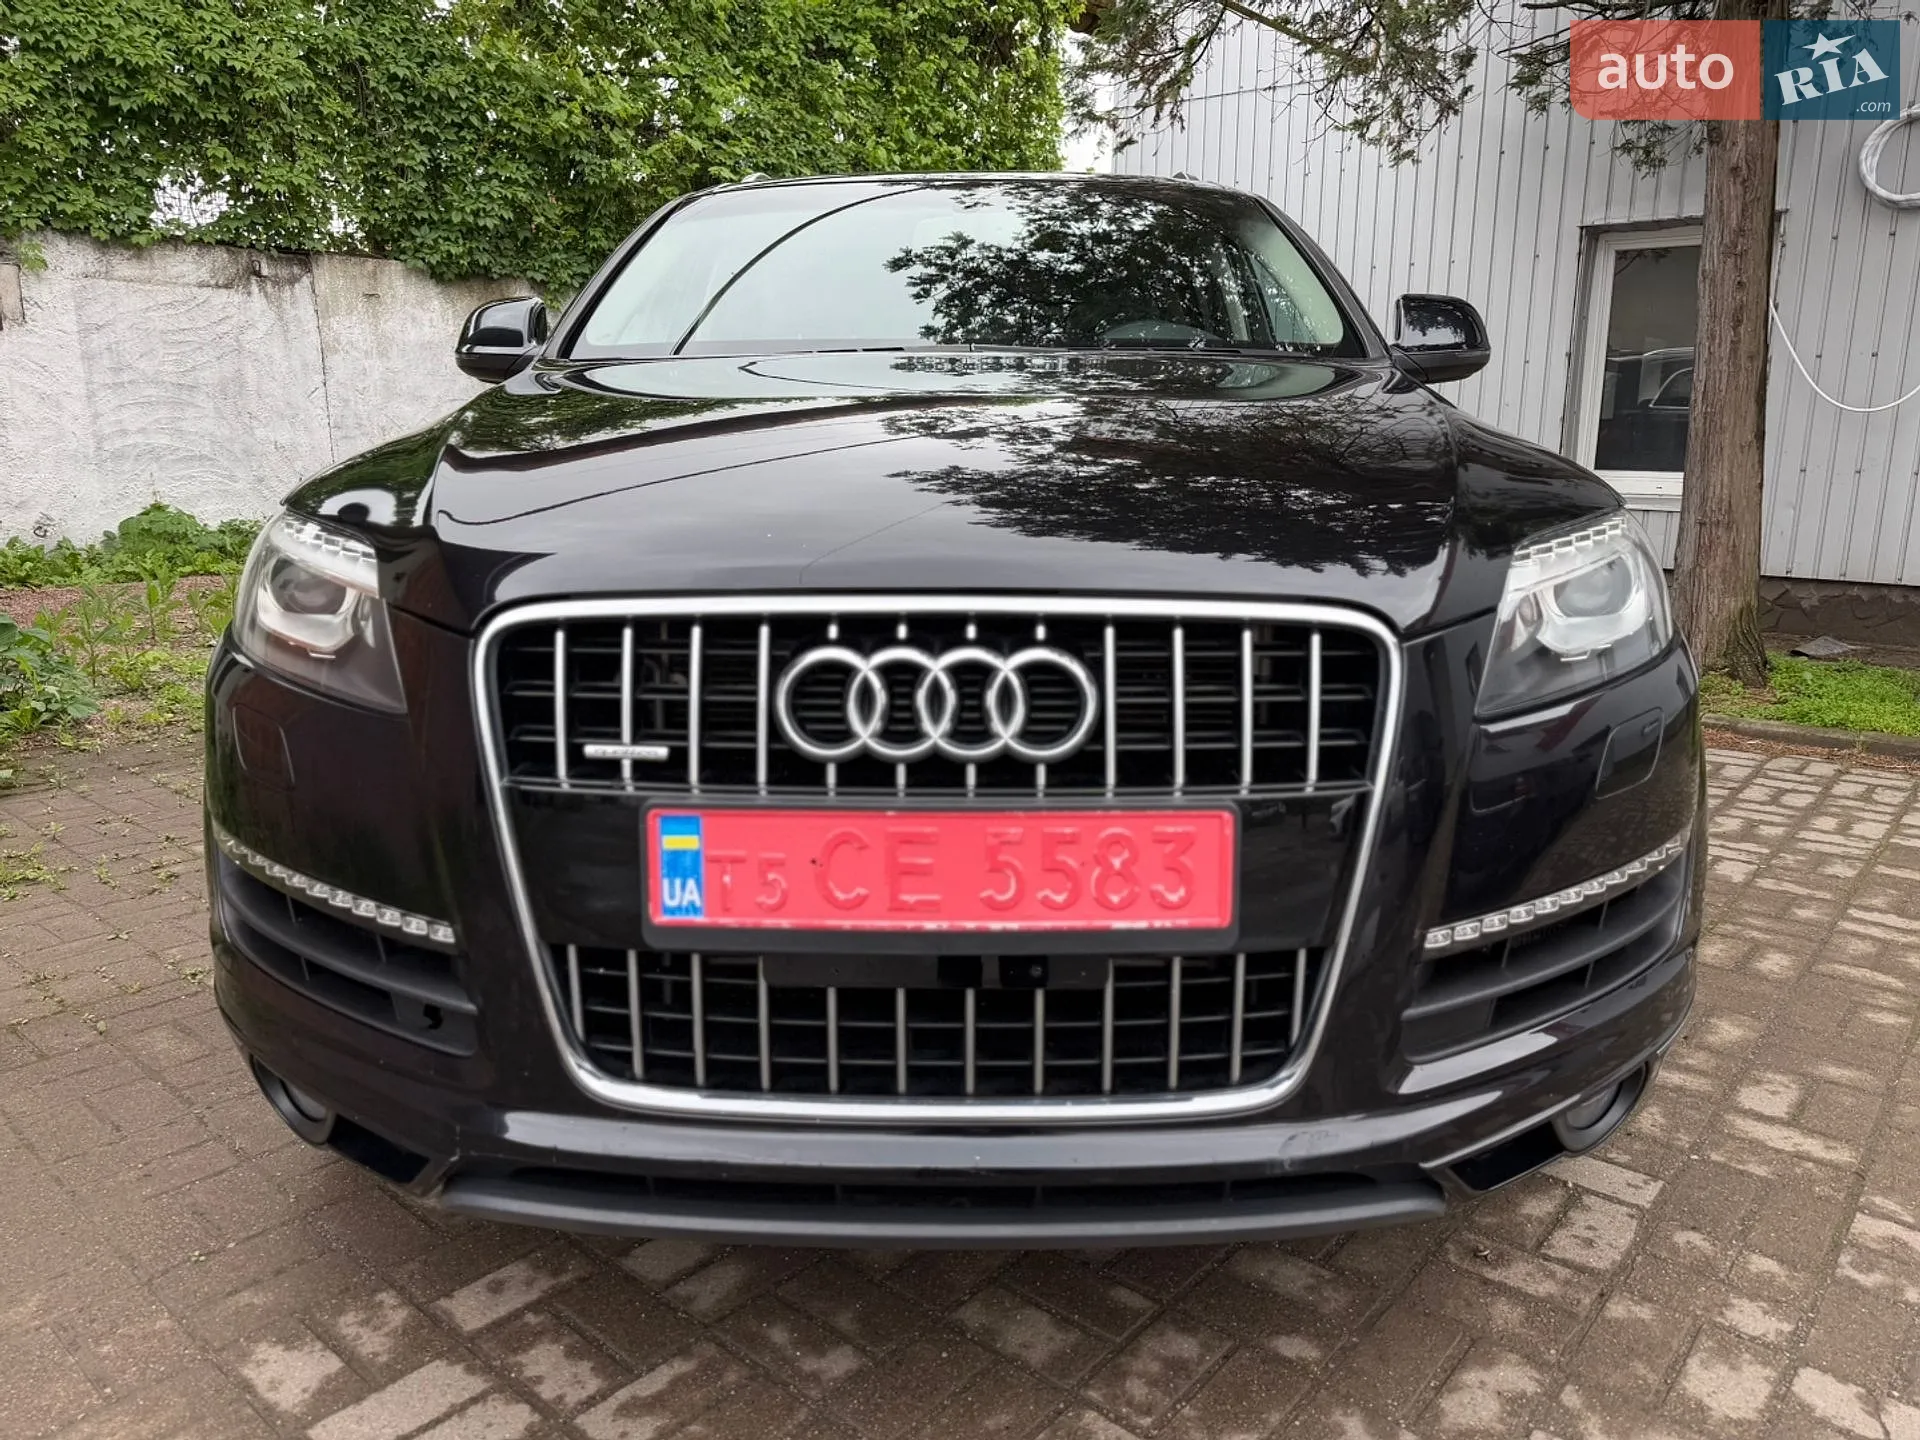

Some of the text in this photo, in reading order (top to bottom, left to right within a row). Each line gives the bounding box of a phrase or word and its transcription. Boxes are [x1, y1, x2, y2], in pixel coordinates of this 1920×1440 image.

[662, 877, 702, 908] UA
[814, 826, 942, 912] CE
[979, 825, 1197, 912] 5583
